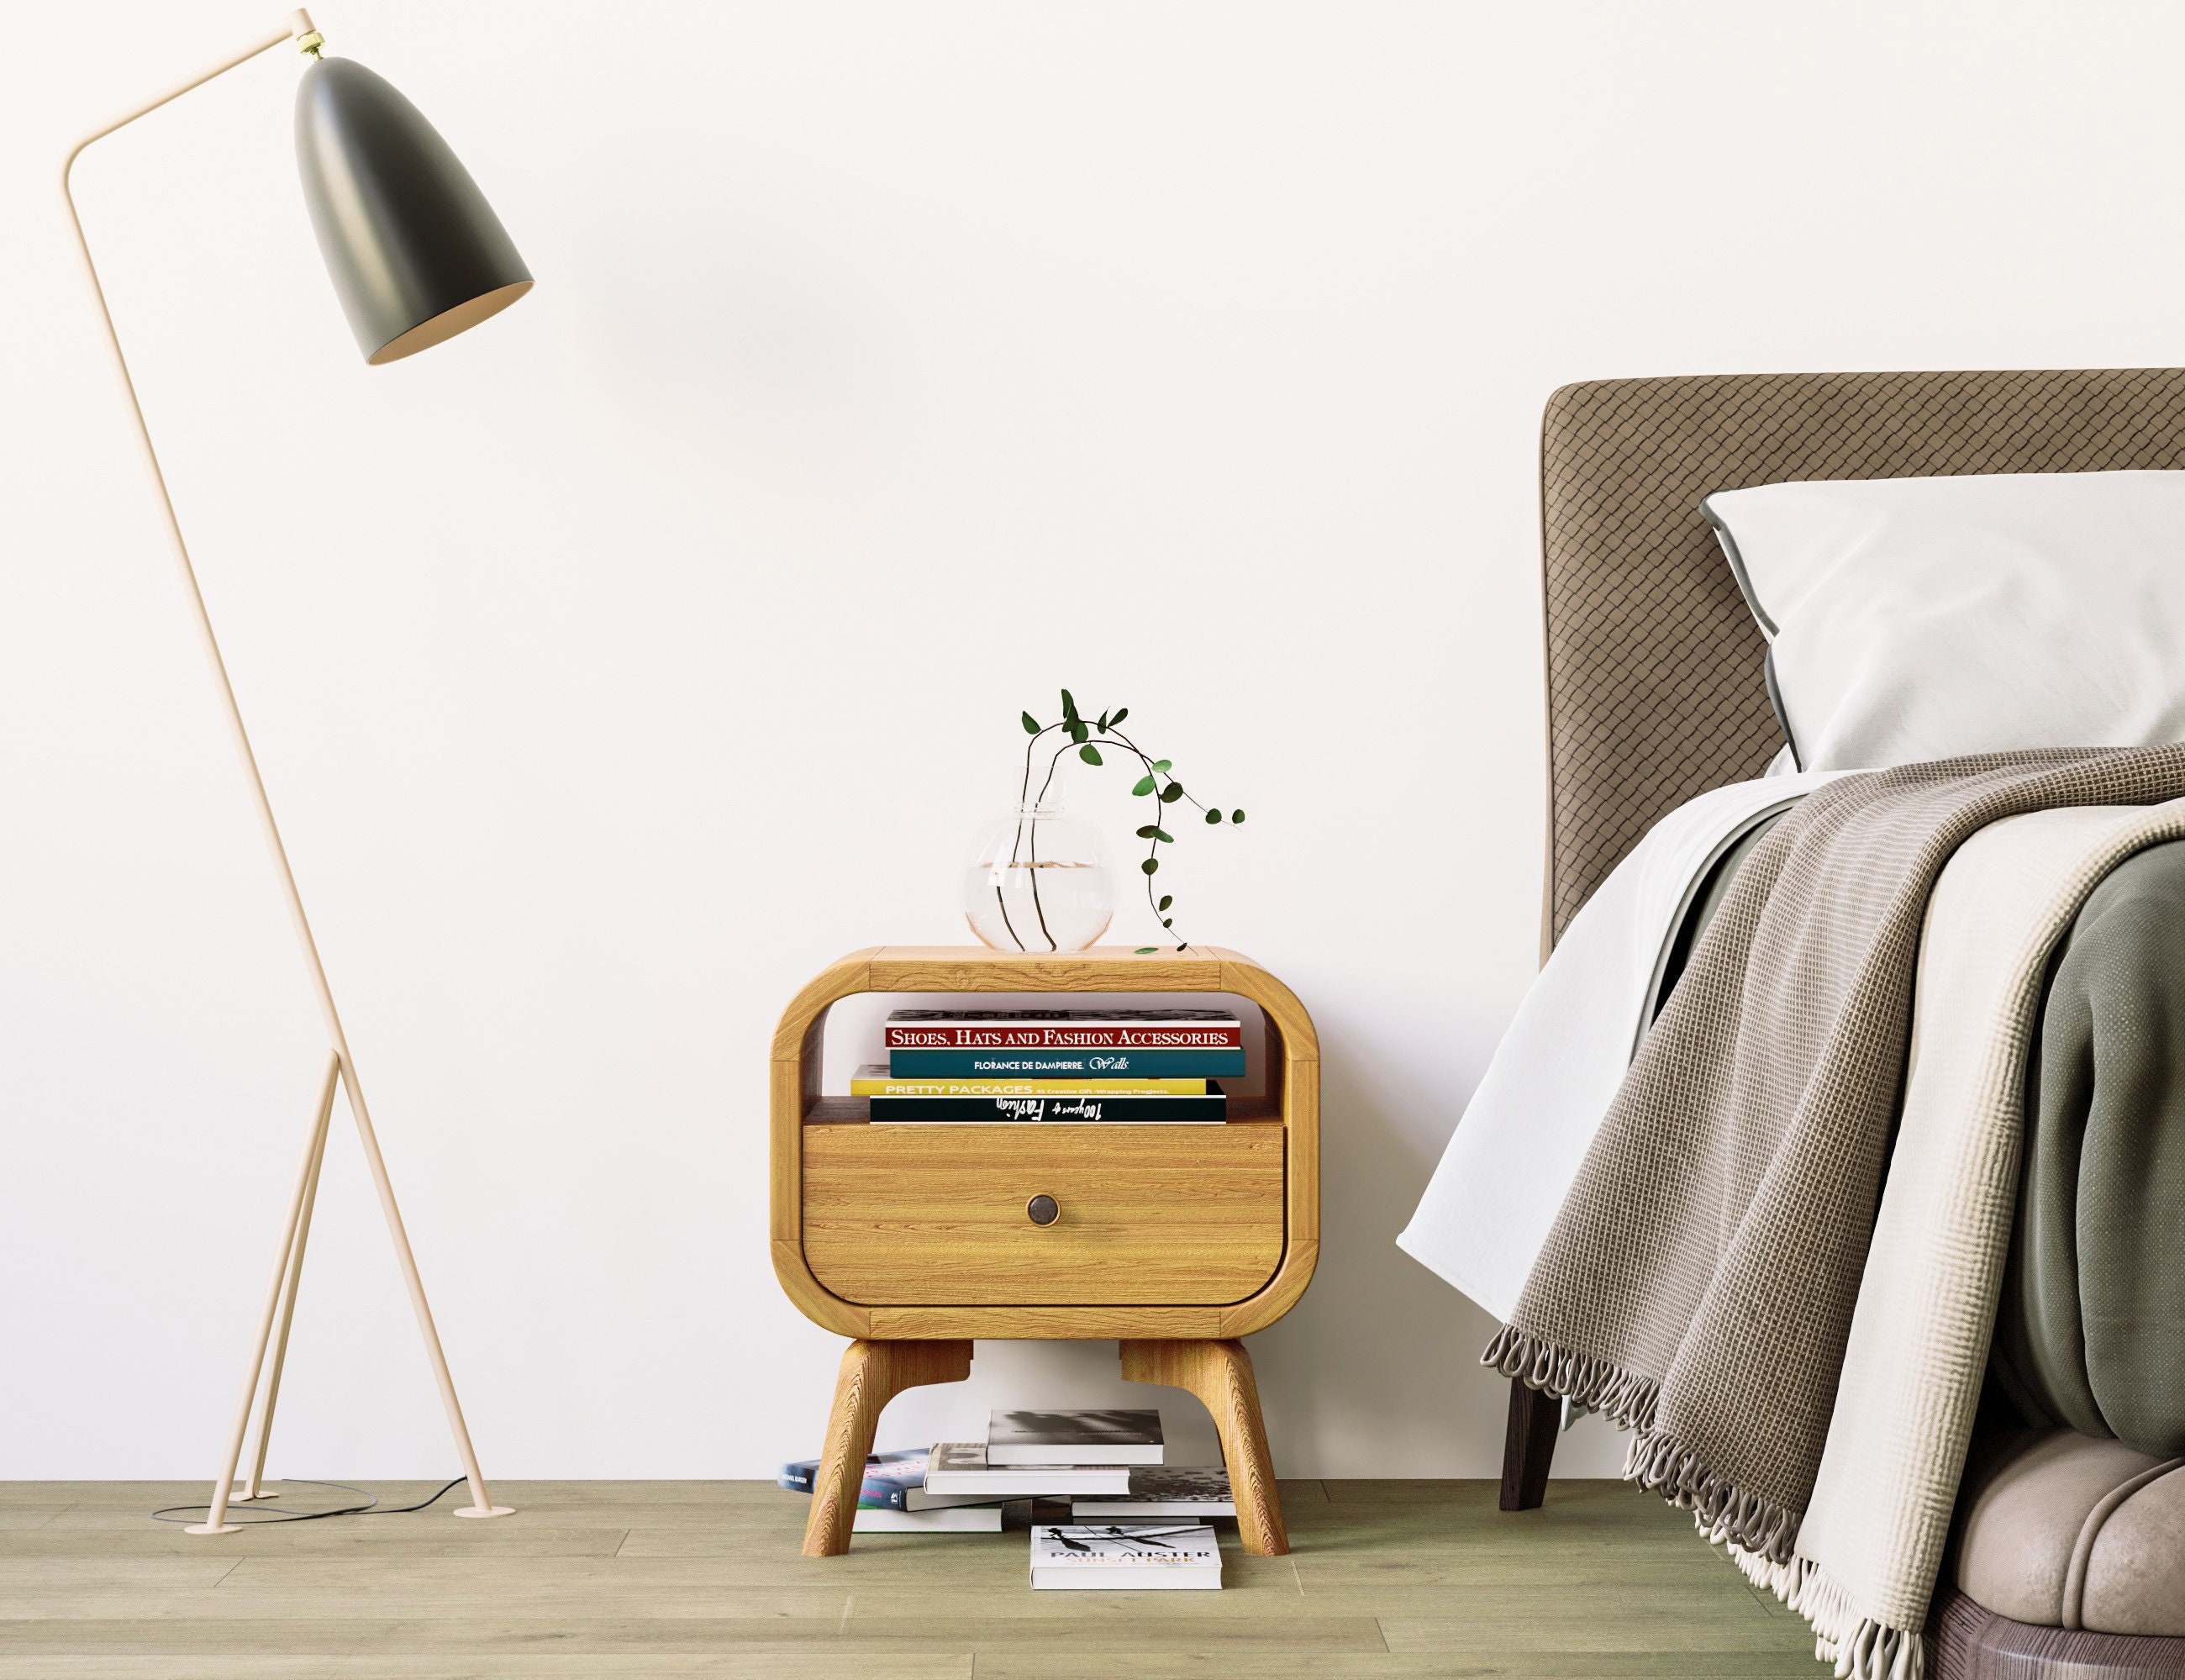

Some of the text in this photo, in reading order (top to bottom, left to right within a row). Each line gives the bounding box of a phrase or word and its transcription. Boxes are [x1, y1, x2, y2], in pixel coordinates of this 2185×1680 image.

[892, 1029, 1229, 1045] SHOES, HATS AND FASHION ACCESSORIES
[974, 1061, 1020, 1070] FLORANCE
[1022, 1061, 1034, 1070] DE
[886, 1086, 945, 1094] PRETTY
[950, 1086, 1033, 1094] PACKAGES
[996, 1098, 1045, 1122] Fashion
